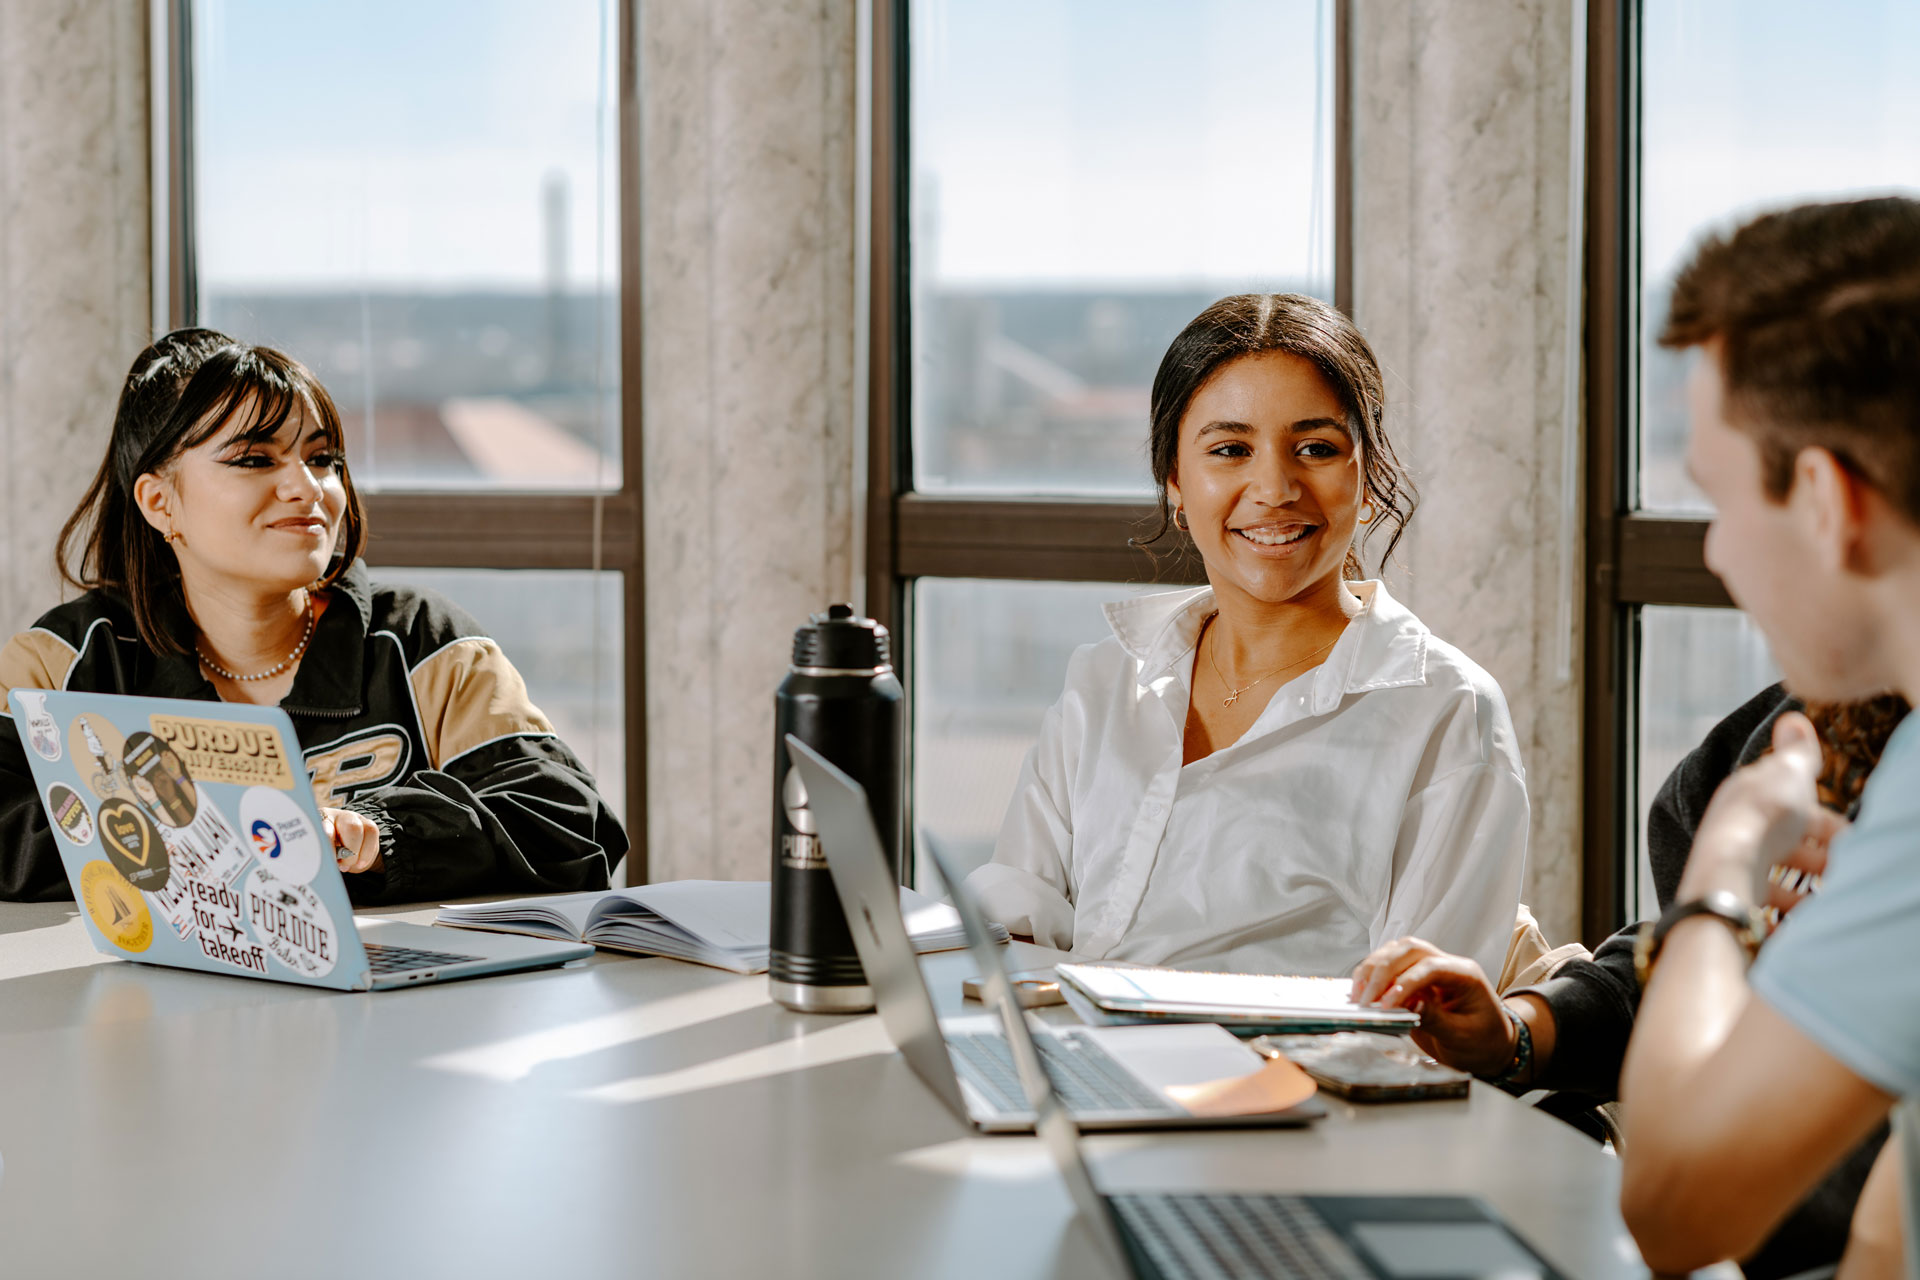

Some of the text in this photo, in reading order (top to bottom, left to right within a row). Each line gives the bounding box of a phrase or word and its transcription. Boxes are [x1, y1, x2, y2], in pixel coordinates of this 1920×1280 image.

[154, 720, 279, 759] PURDUE
[180, 751, 286, 776] NIVERSITY
[169, 834, 208, 876] SAN
[191, 806, 232, 861] JUAN
[277, 818, 301, 830] Peace
[282, 828, 307, 842] Corps
[781, 834, 827, 859] PURD
[189, 880, 240, 918] ready
[191, 901, 216, 931] for
[250, 893, 331, 961] PURDUE
[198, 930, 266, 973] takeoff
